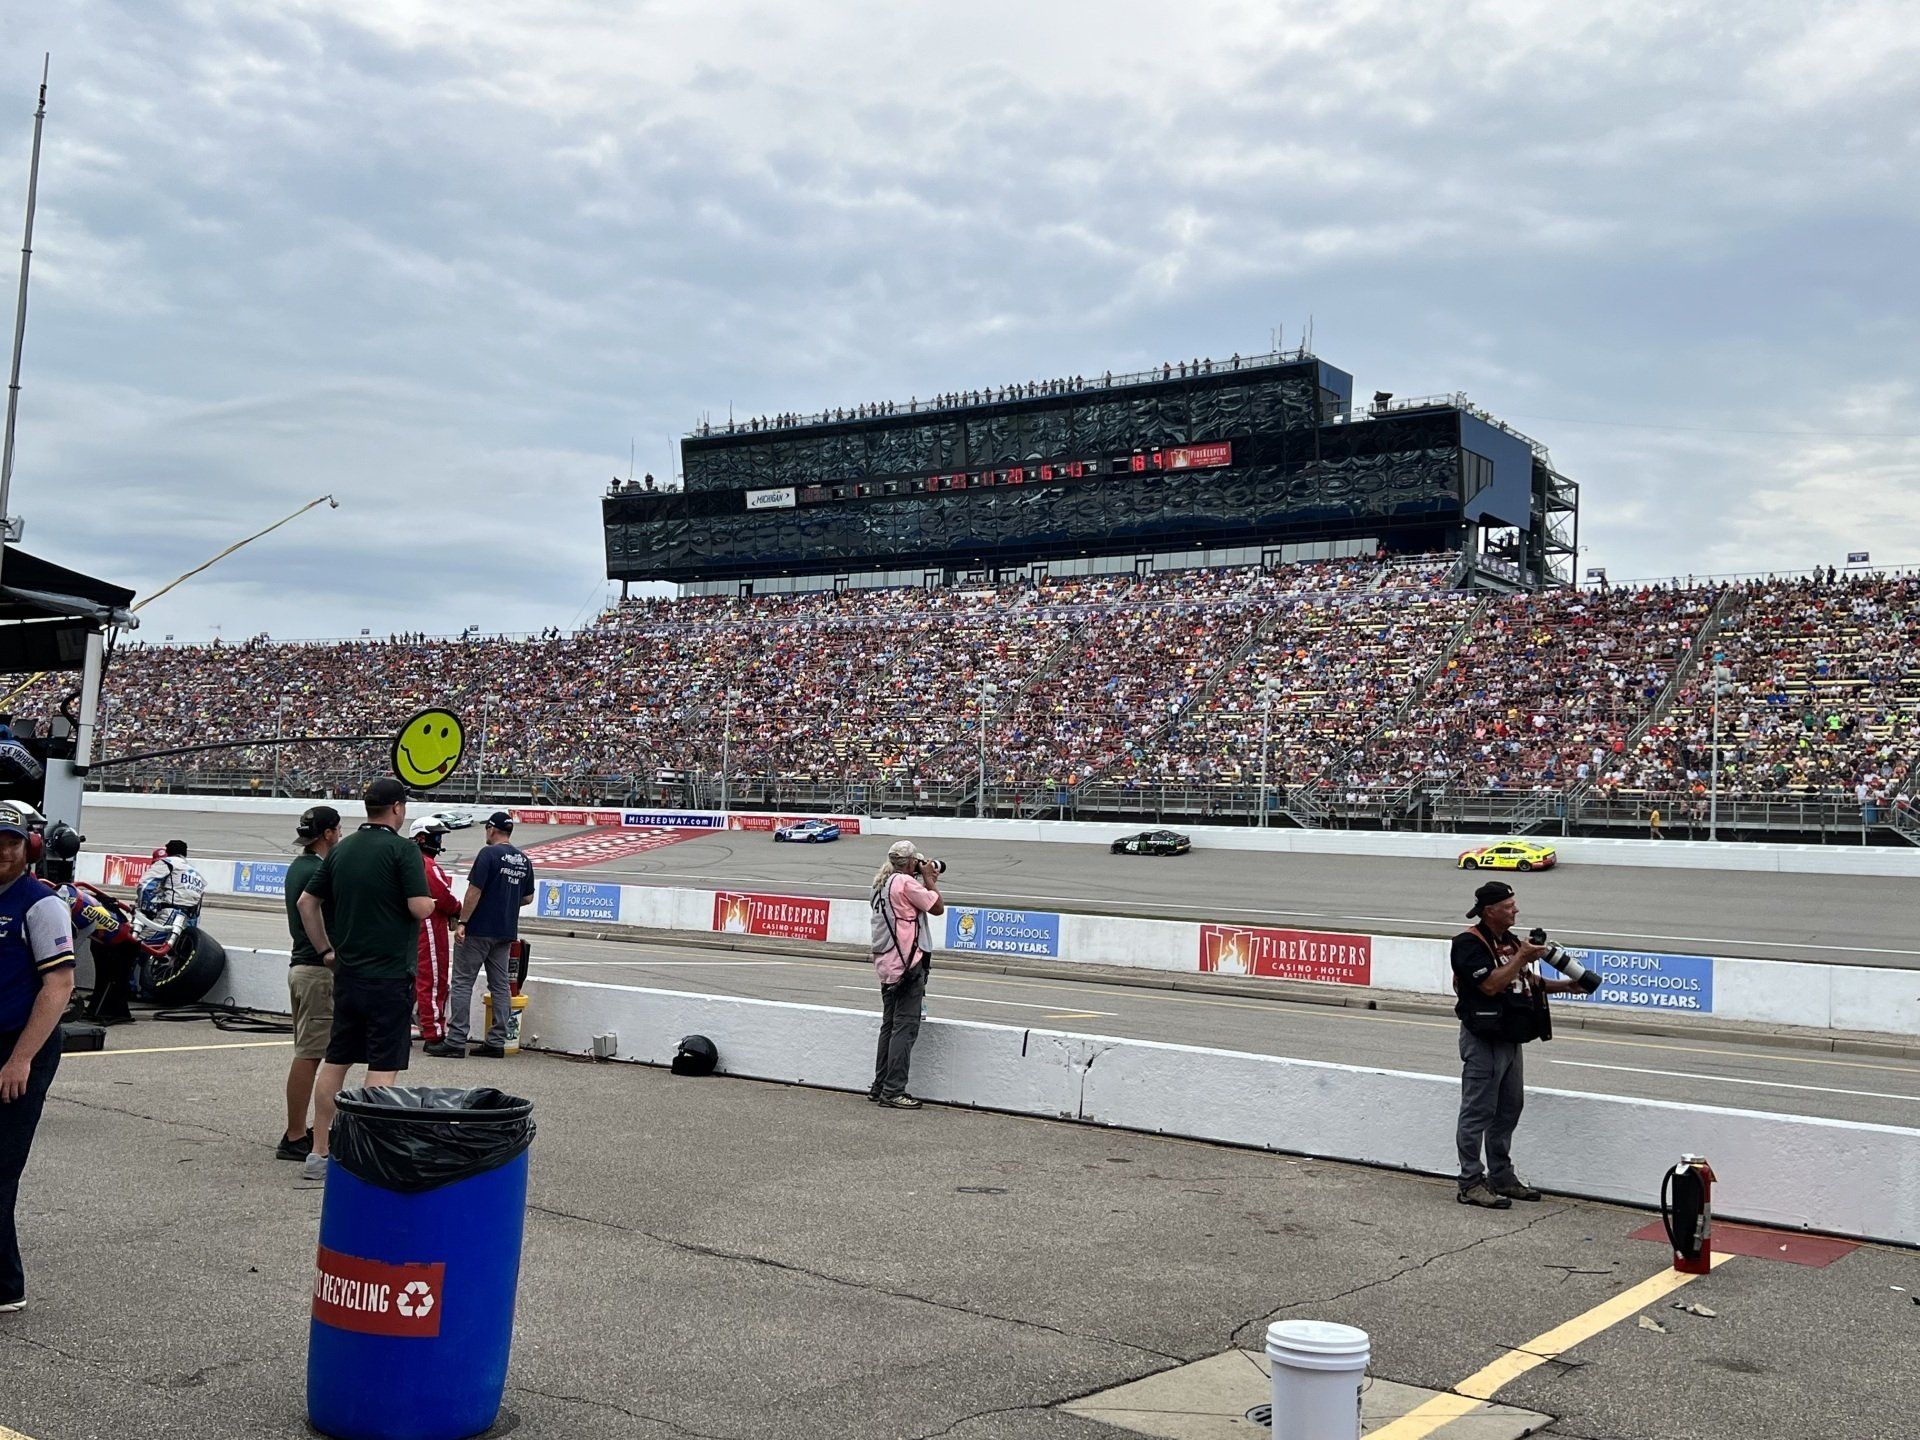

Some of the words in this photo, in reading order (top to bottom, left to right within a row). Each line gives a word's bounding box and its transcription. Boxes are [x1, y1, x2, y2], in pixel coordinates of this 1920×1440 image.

[1153, 453, 1162, 469] 9
[756, 494, 783, 504] MICHIGAN
[1408, 594, 1423, 603] ally
[1447, 592, 1463, 601] ally
[628, 816, 709, 825] MISPEEDWAY.com
[1126, 841, 1139, 851] 45
[1480, 856, 1495, 865] 12
[568, 884, 581, 894] FOR
[567, 896, 581, 905] FOR
[581, 897, 615, 907] SCHOOLS.
[83, 905, 119, 932] SUNOCO
[566, 908, 580, 917] FOR
[581, 909, 590, 917] 50
[590, 910, 613, 919] YEARS.
[756, 902, 825, 925] FIREKEEPERS
[987, 911, 1005, 922] FOR
[1006, 913, 1026, 924] FUN.
[762, 922, 789, 931] CASINO
[794, 926, 817, 934] HOTEL
[986, 925, 1004, 936] FOR
[1005, 927, 1051, 940] SCHOOLS.
[953, 940, 977, 949] LOTTERY
[985, 939, 1004, 950] FOR
[1004, 941, 1017, 951] 50
[1018, 942, 1050, 954] YEARS.
[1262, 937, 1366, 966] FIREKEEPERS
[1602, 955, 1628, 968] FOR
[1631, 957, 1662, 971] FUN.
[1272, 962, 1302, 973] CASINO
[1320, 967, 1354, 977] HOTEL
[1283, 972, 1312, 981] BATTLE
[1602, 972, 1628, 985] FOR
[1631, 974, 1701, 991] SCHOOLS.
[1601, 990, 1628, 1003] FOR
[1631, 991, 1649, 1004] 50
[1651, 993, 1700, 1009] YEARS.
[322, 1272, 390, 1313] RECYCLING
